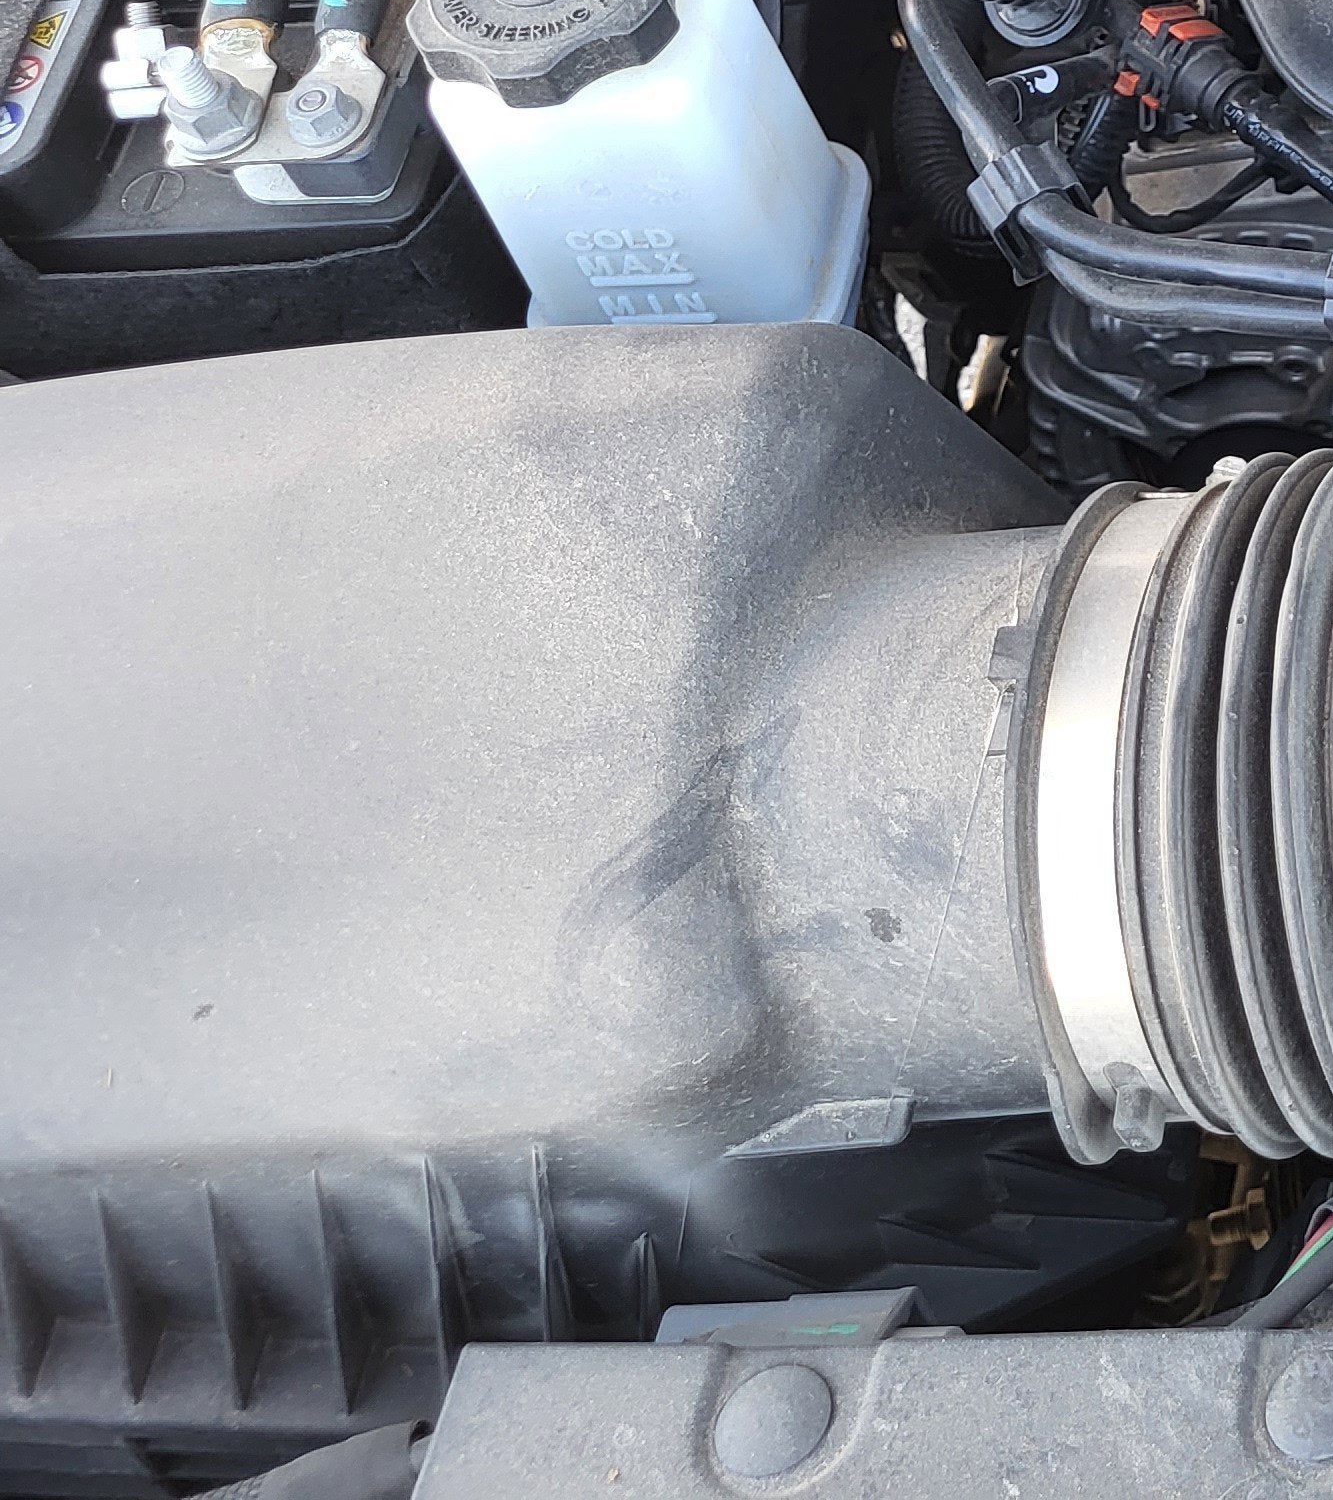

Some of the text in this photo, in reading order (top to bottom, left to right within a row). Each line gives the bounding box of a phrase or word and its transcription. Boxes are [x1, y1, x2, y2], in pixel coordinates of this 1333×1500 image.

[477, 7, 591, 43] STEERING
[565, 228, 675, 251] COLD
[576, 251, 690, 277] MAX
[598, 291, 708, 316] MIN
